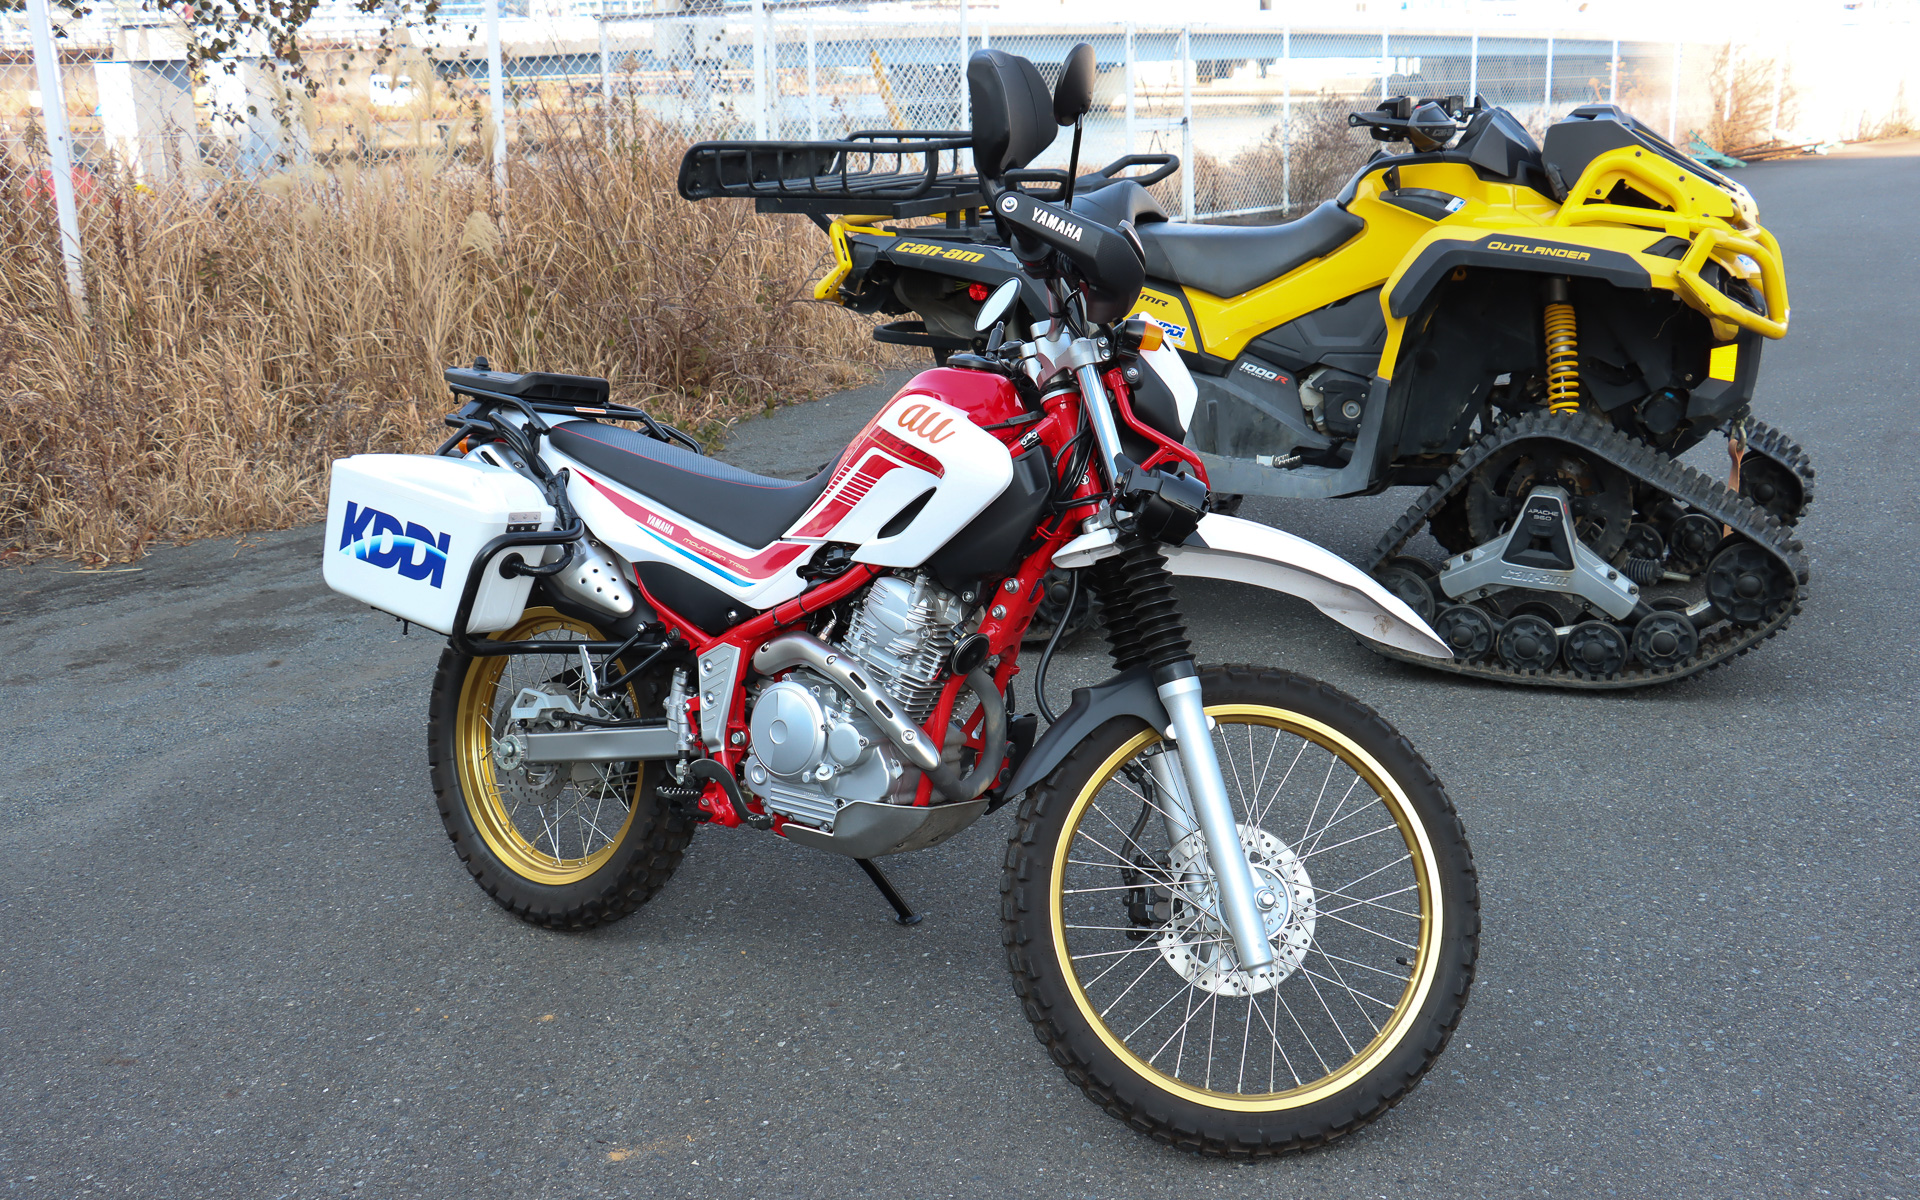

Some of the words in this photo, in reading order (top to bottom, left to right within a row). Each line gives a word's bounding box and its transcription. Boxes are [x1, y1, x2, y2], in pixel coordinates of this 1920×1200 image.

[1032, 206, 1083, 242] YAMAHA
[895, 242, 985, 263] can-am
[1487, 241, 1591, 261] OUTLANDER
[1155, 319, 1186, 339] DDI
[1239, 361, 1289, 385] 1000R
[897, 404, 956, 444] au
[1527, 508, 1560, 517] APACHE
[339, 500, 452, 589] KDDI
[646, 513, 675, 536] YAMAHA
[682, 537, 727, 562] MOUNTAIN
[728, 559, 752, 575] TRAIL
